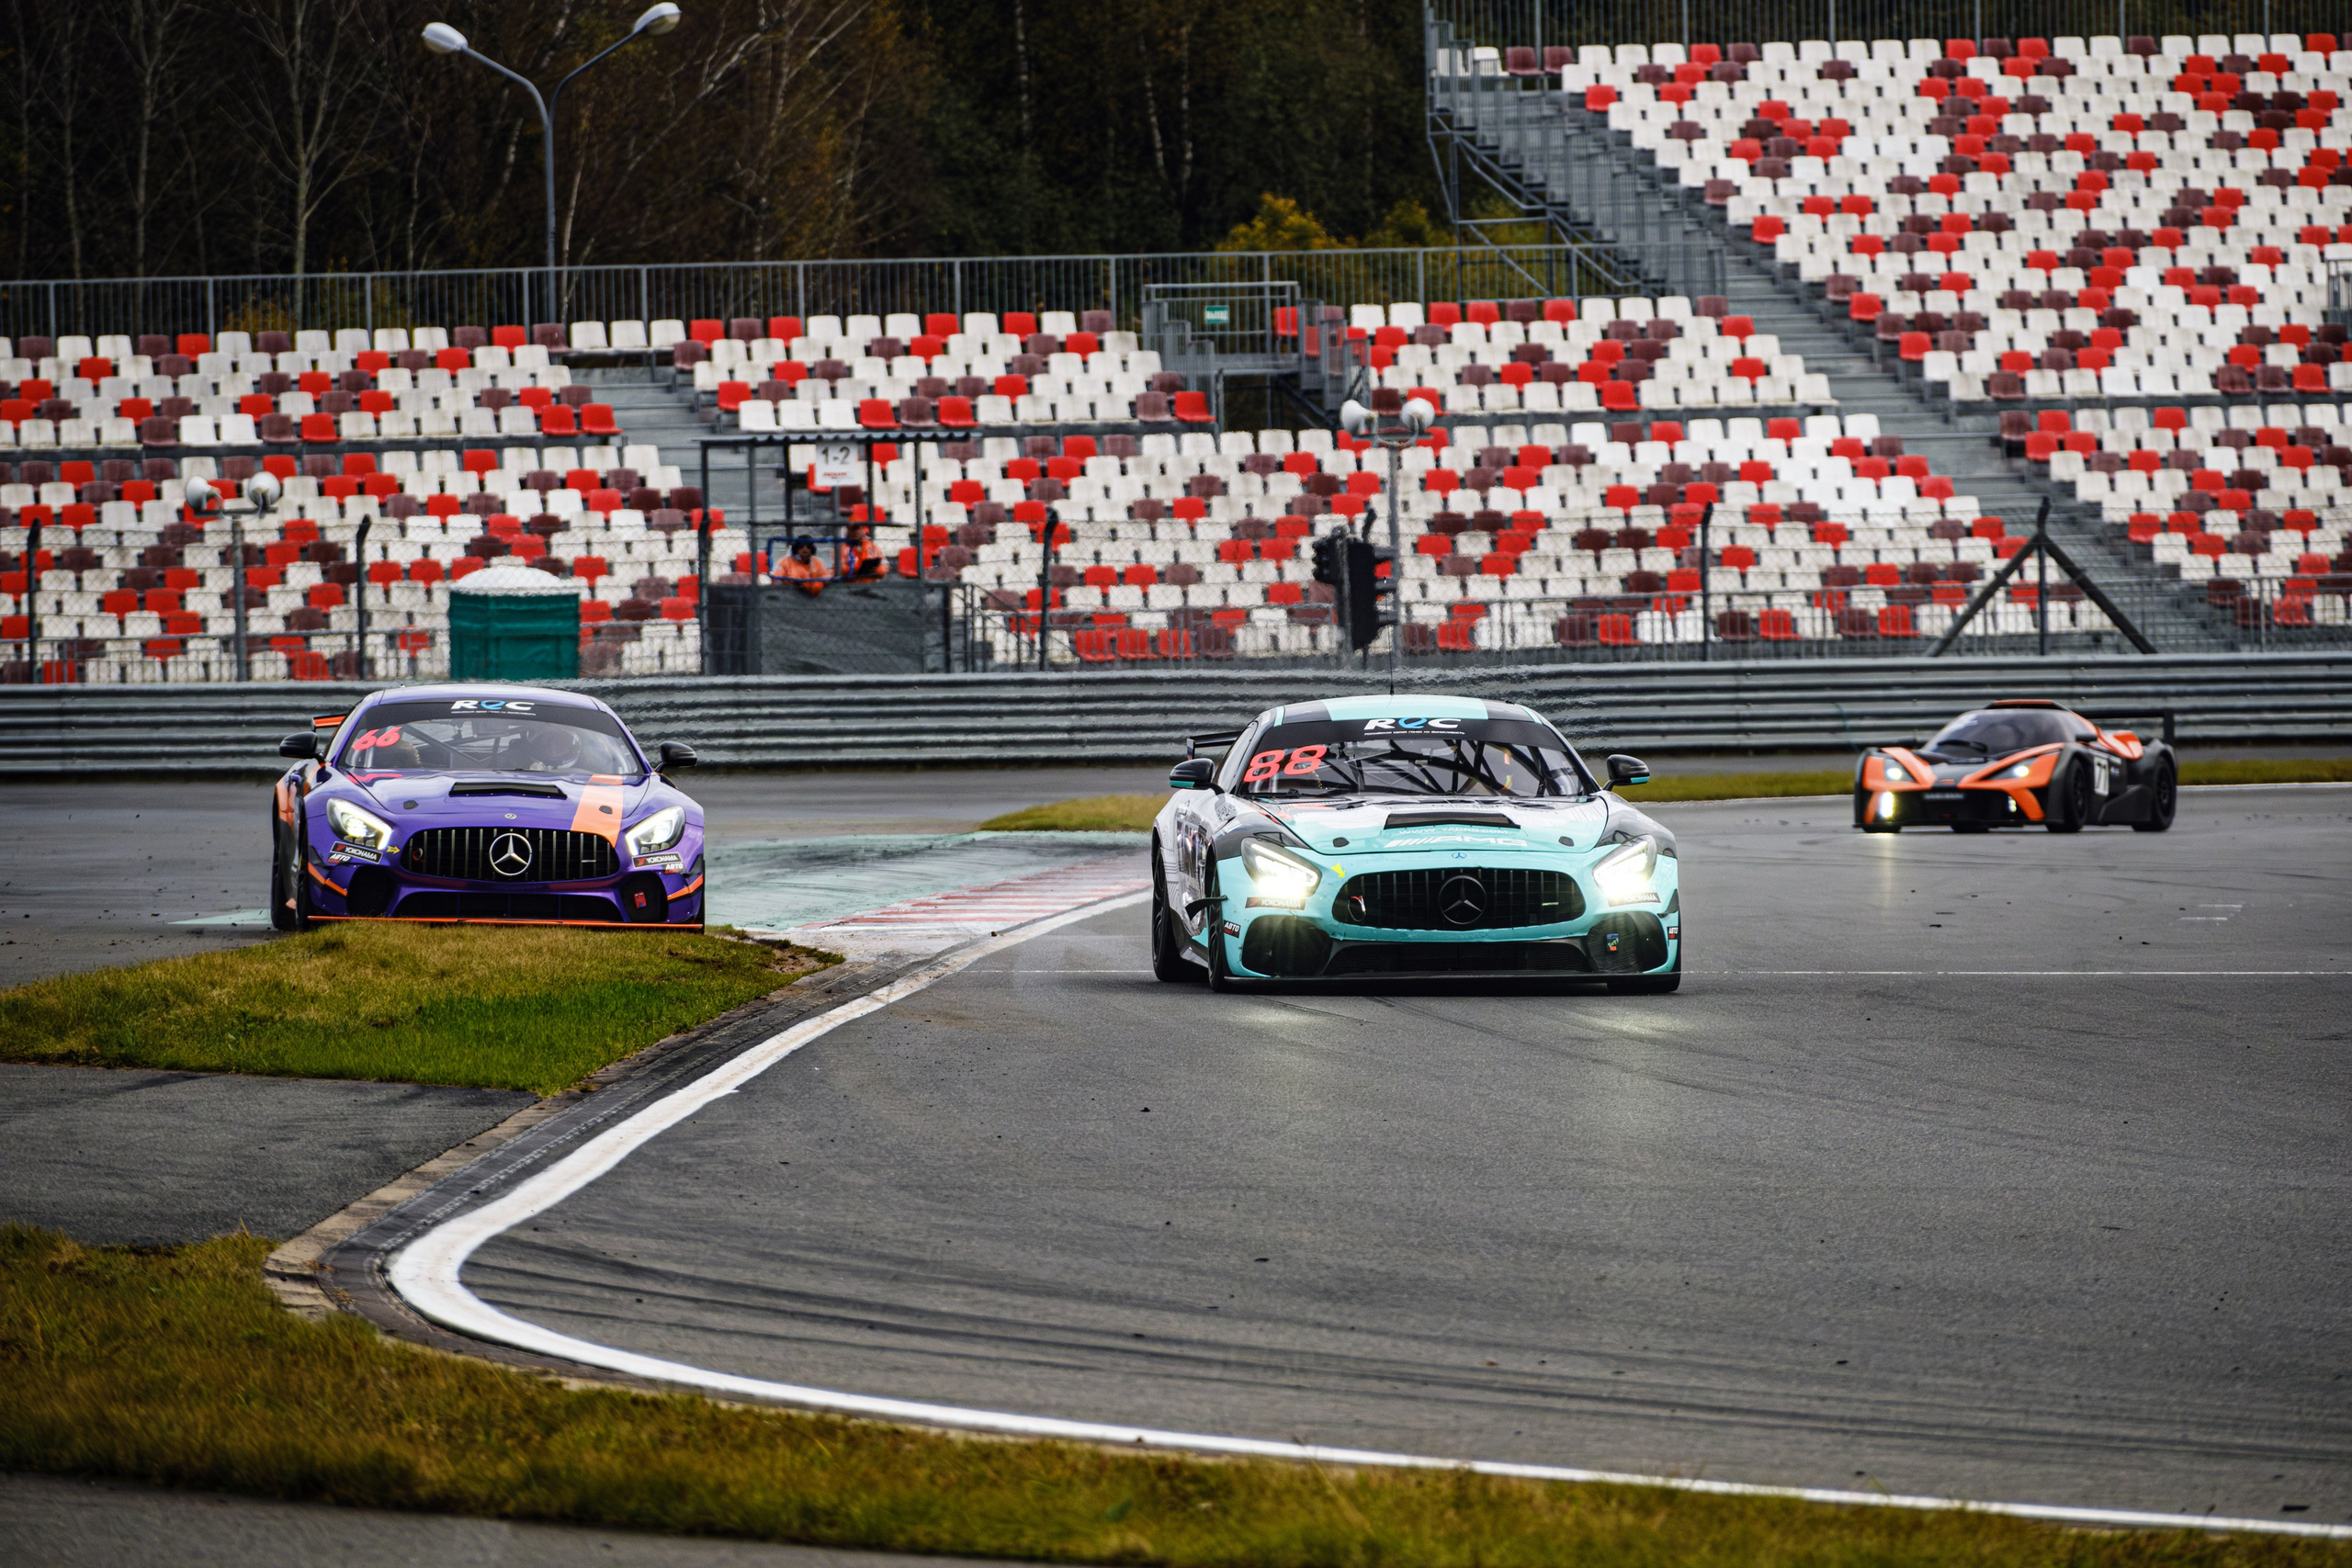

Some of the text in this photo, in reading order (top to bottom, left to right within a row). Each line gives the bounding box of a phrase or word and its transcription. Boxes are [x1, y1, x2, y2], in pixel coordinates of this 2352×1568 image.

[820, 446, 850, 465] 1-2
[353, 726, 402, 750] 66
[1243, 745, 1328, 783] 88
[1430, 836, 1528, 847] AMG
[345, 846, 378, 861] YOKOHAMA
[647, 855, 678, 863] YOKOHAMA
[1261, 898, 1301, 908] YOKOHAMA
